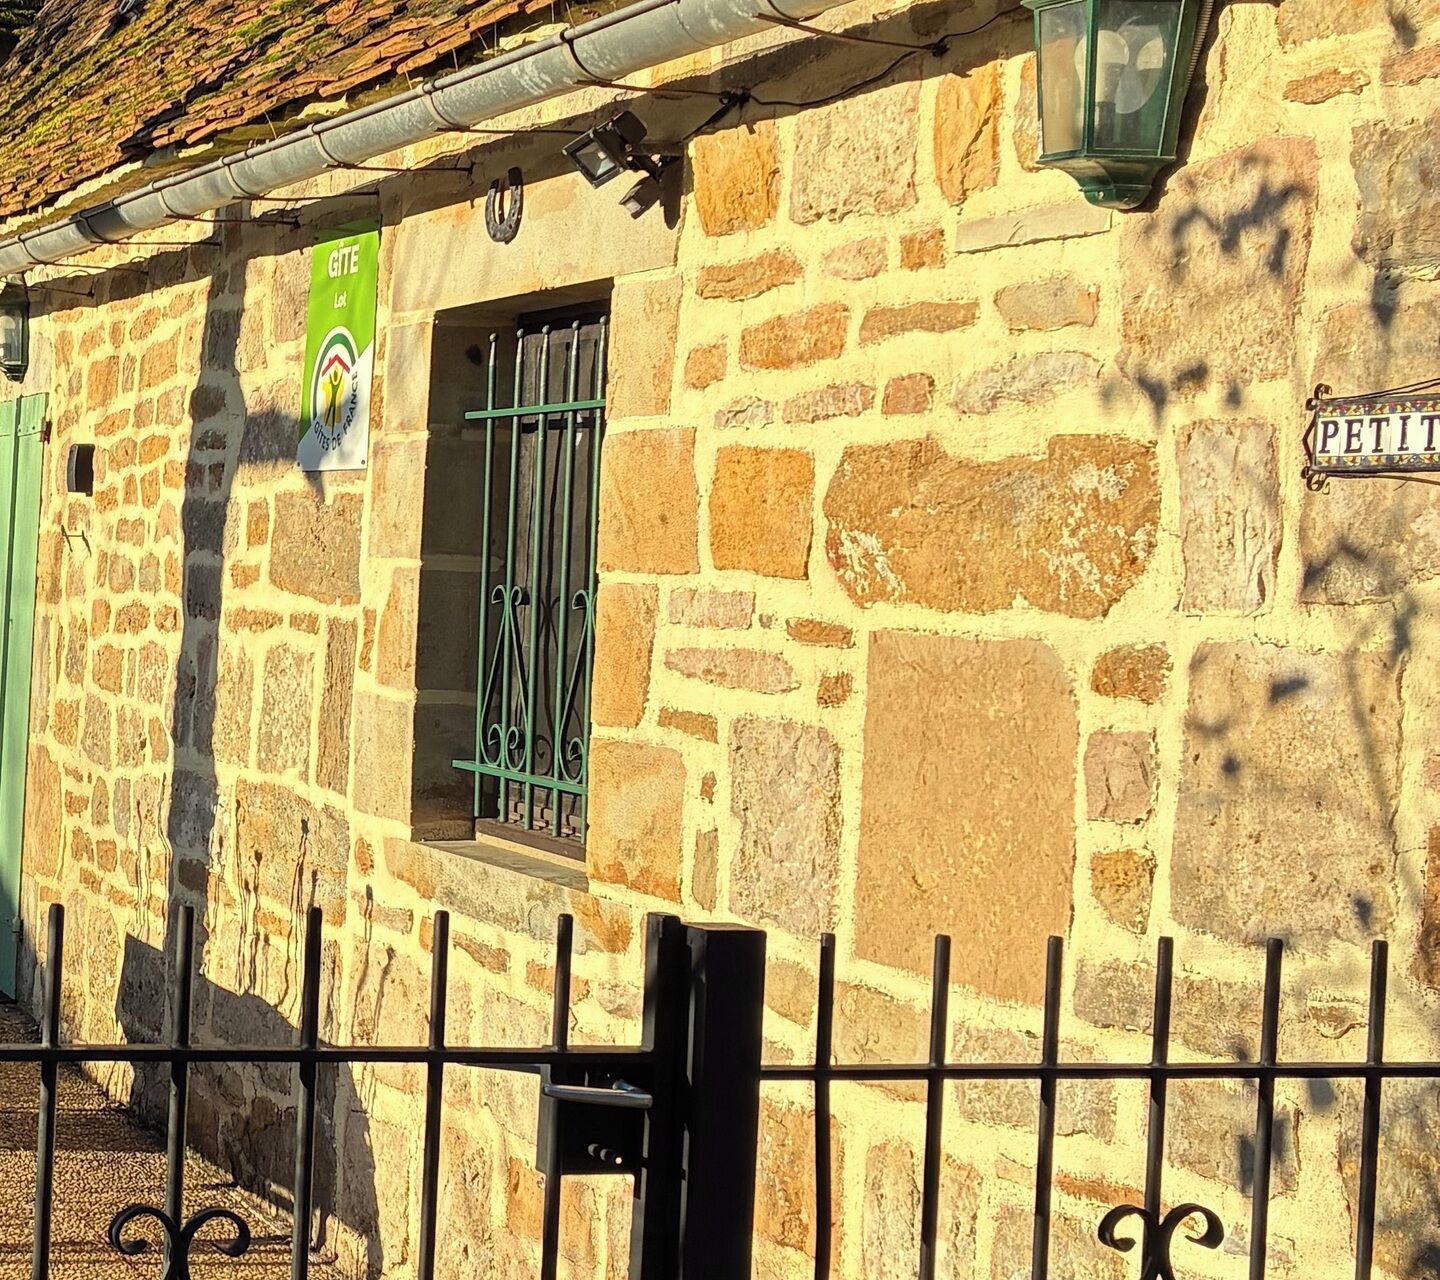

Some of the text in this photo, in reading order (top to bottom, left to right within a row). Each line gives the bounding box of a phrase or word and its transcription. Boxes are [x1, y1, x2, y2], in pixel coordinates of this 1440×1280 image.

[328, 240, 360, 278] GÎTE
[334, 291, 347, 309] Lot
[332, 433, 342, 451] DE
[342, 371, 358, 435] FRANCE
[1318, 415, 1440, 453] PETIT
